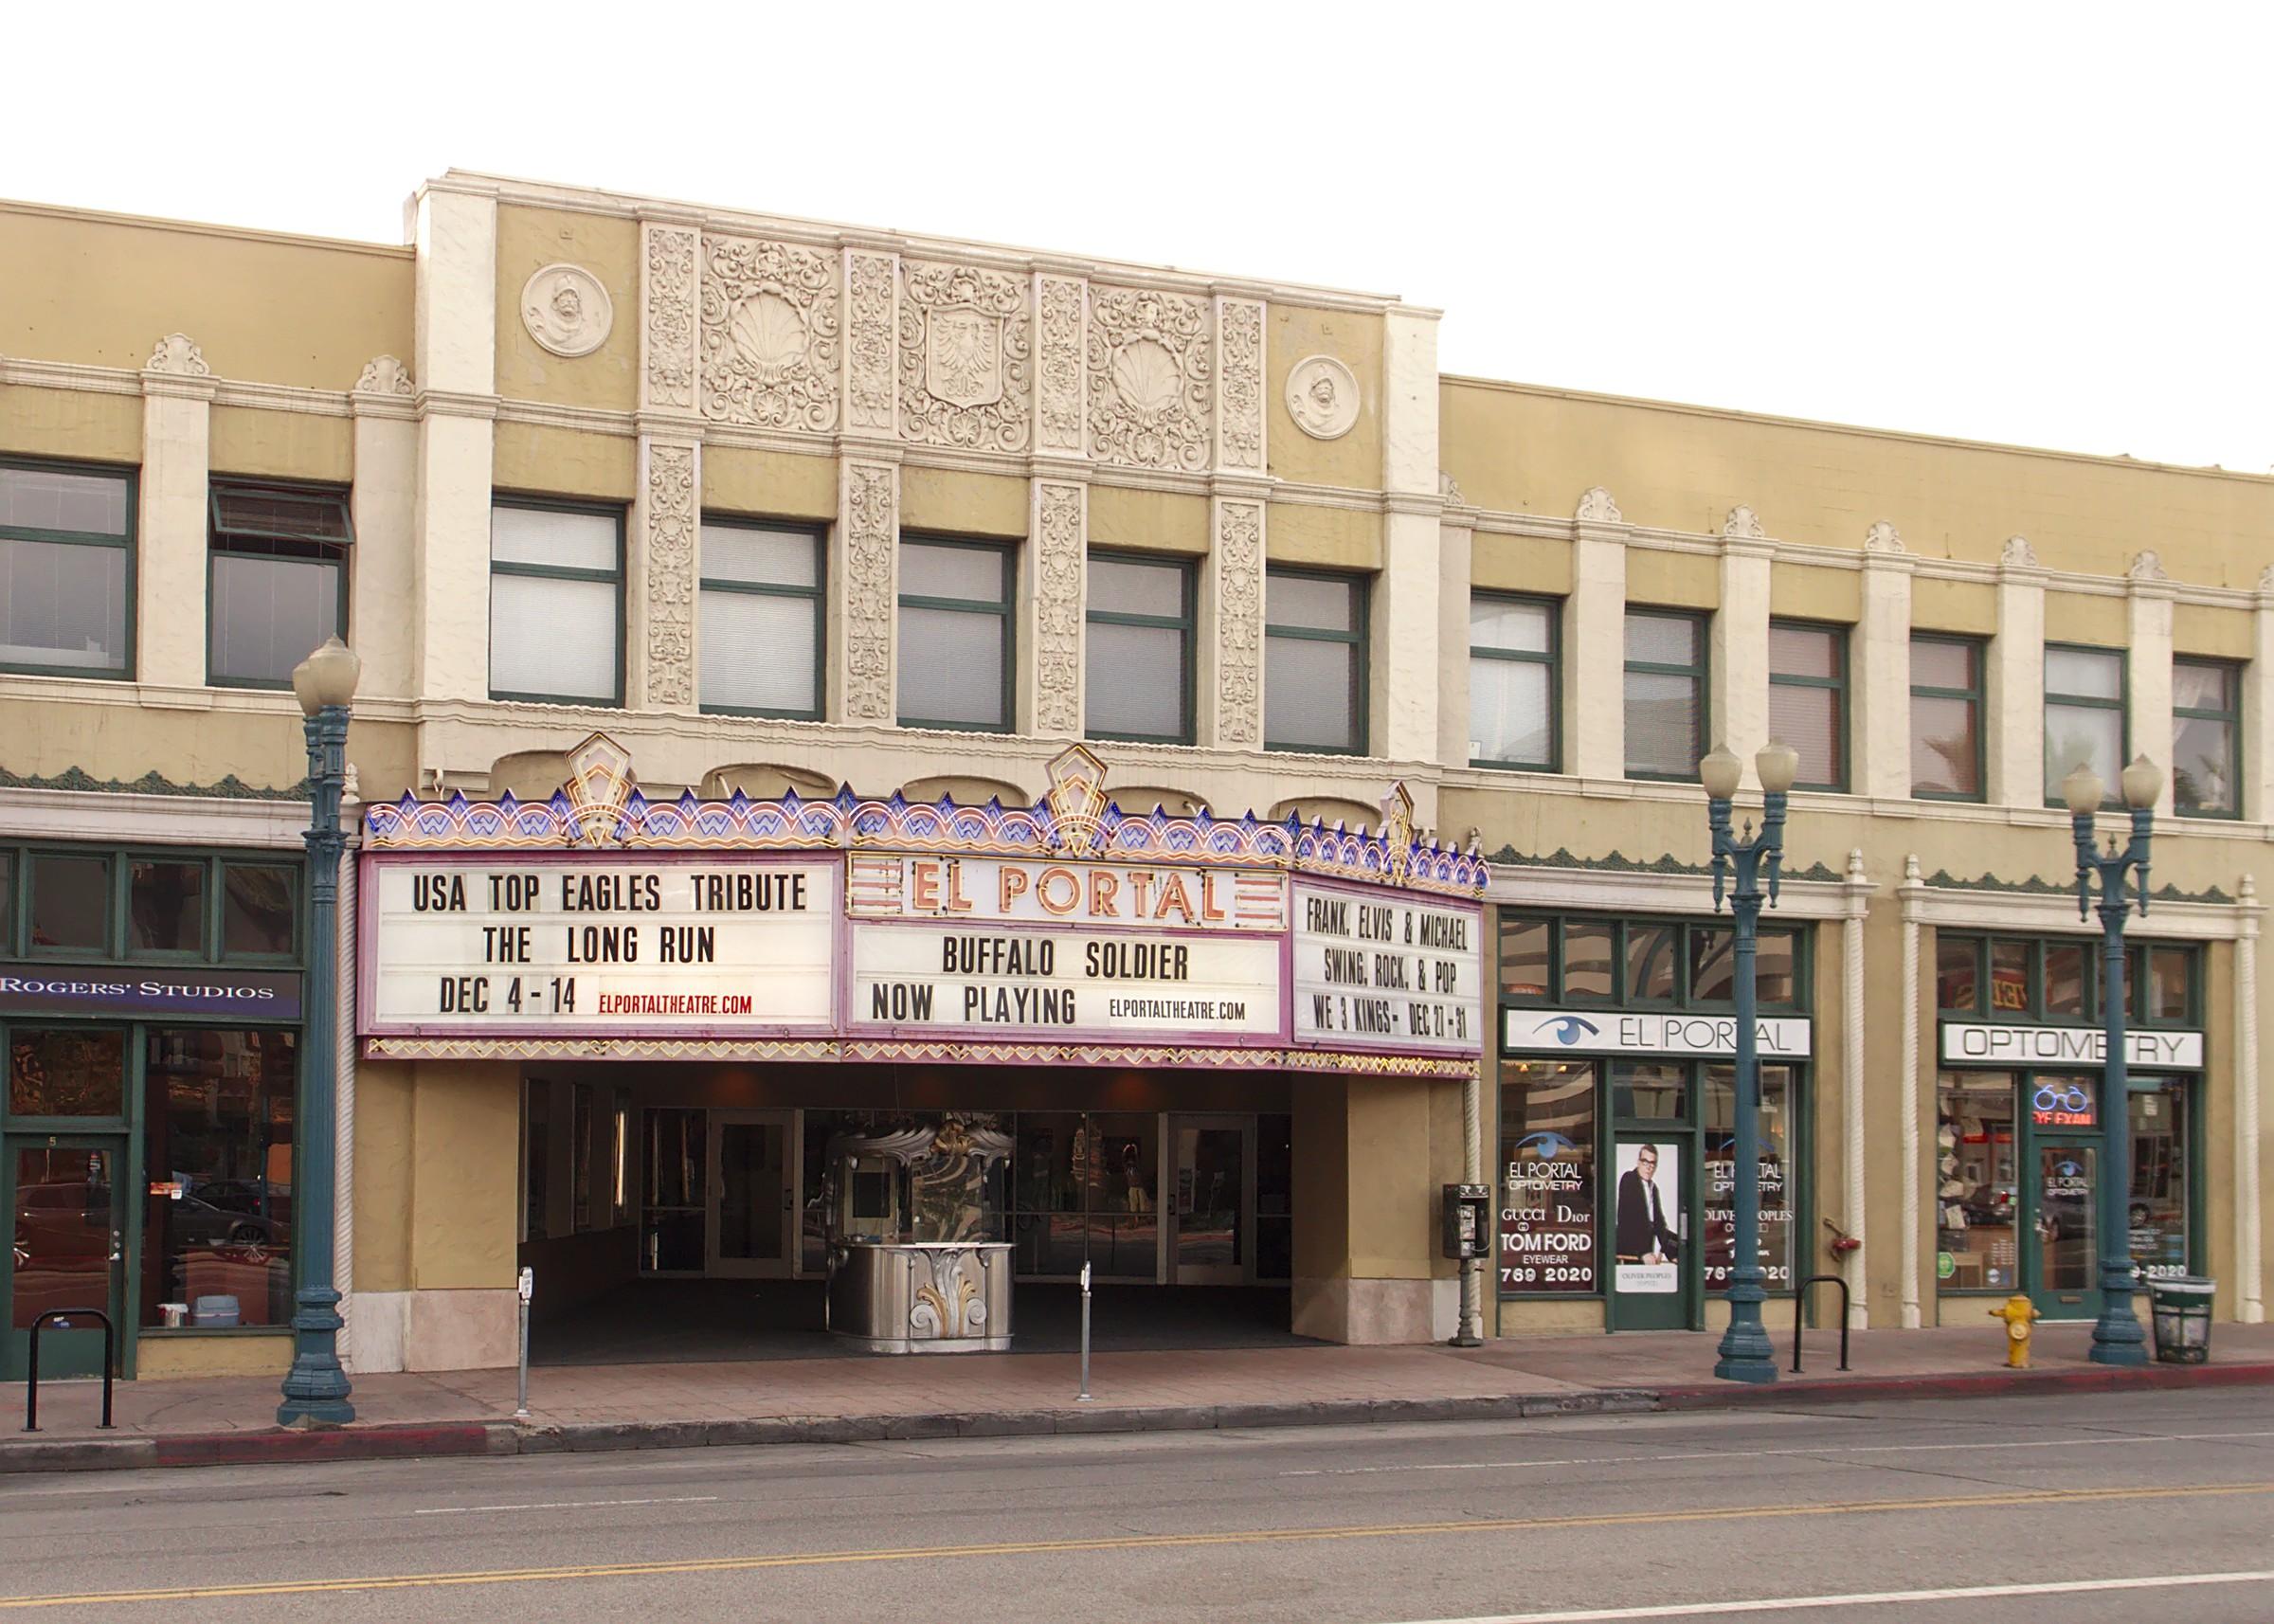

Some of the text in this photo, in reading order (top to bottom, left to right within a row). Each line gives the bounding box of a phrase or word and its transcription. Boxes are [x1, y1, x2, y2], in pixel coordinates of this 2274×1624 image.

[413, 873, 806, 911] USA TOP EAGLES TRIBUTE
[914, 863, 1225, 921] EL PORTAL
[1359, 905, 1392, 941] ELVIS
[1405, 912, 1413, 944] &
[1420, 914, 1468, 950] MICHAEL
[483, 926, 714, 963] THE LONG RUN
[943, 937, 1188, 980] BUFFALO SOLDIER
[140, 982, 274, 999] STUDIOS
[1418, 959, 1426, 991] &
[1435, 961, 1456, 993] POP
[441, 977, 488, 1013] DEC
[600, 994, 751, 1014] ELPORTALTHEATRE.COM
[873, 983, 1245, 1024] NOW PLAYING ELPORTALTHEATRE.COM
[1313, 994, 1332, 1029] WE
[1341, 997, 1347, 1030] 3
[1409, 1002, 1430, 1035] DEC
[1620, 1018, 1791, 1051] EL PORAL
[1508, 1180, 1583, 1191] OPTOMETRY
[1509, 1162, 1581, 1179] EL PORTAL
[1714, 1163, 1727, 1178] EL
[1502, 1208, 1545, 1221] GUCCI
[1704, 1209, 1736, 1221] OLIVE
[1501, 1234, 1592, 1251] TOM FORD
[1523, 1254, 1569, 1265] EYEWEAR
[1544, 1268, 1592, 1282] 2020
